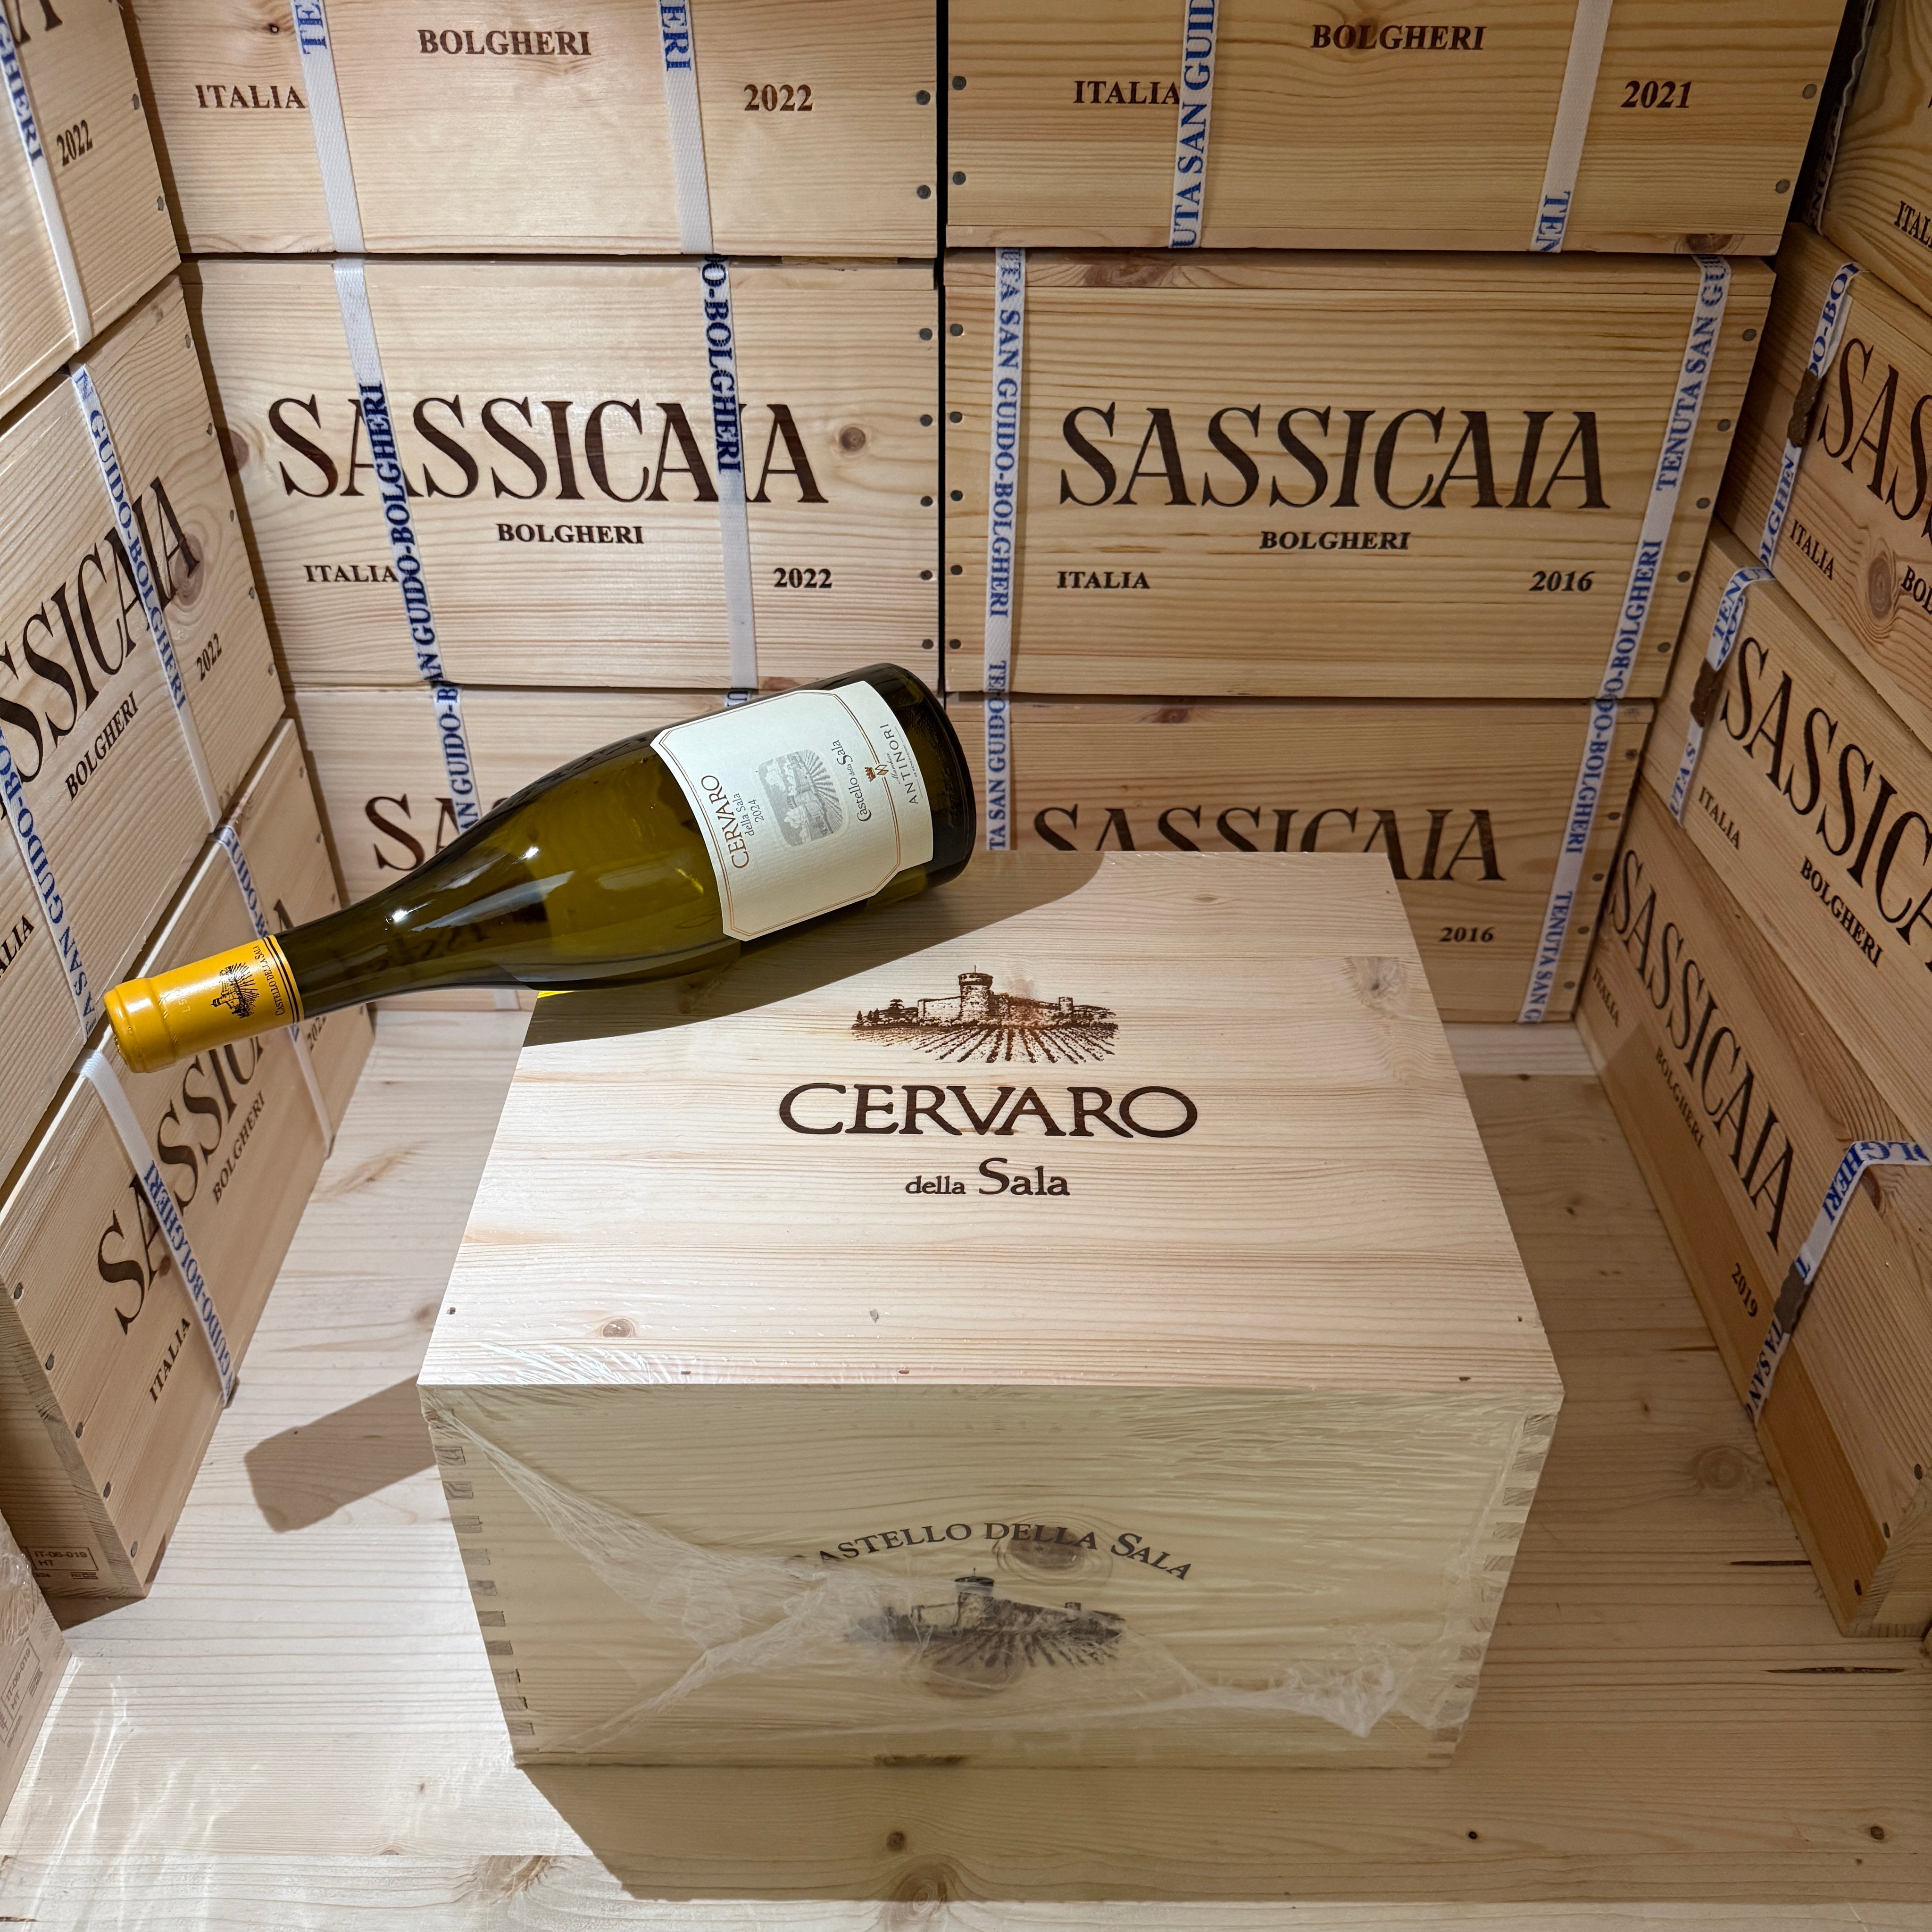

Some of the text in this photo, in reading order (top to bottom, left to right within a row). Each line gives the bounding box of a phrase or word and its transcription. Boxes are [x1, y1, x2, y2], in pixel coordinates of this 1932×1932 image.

[417, 29, 592, 56] BOLGHERI
[1310, 24, 1487, 50] BOLGHERI
[195, 84, 814, 112] ITALIA 2022
[1073, 80, 1692, 108] ITALIA 2021
[57, 119, 93, 167] 2022
[1177, 103, 1207, 175] SAN
[1893, 200, 1932, 249] ITAL
[998, 309, 1021, 369] SAN
[1656, 380, 1702, 491] TENUTA
[1685, 316, 1718, 374] SAN
[268, 394, 829, 503] SASSICAA
[1060, 401, 1611, 510] SASSICAIA
[496, 523, 644, 544] BOLGHERI
[1260, 531, 1411, 550] BOLGHERI
[1790, 519, 1834, 581] ITALIA
[304, 565, 833, 589] ITALIA 2022
[1057, 570, 1596, 592] ITALIA 2016
[196, 633, 223, 682] 2022
[65, 691, 139, 801] BOLGHERI
[832, 740, 854, 766] Sala
[880, 724, 919, 804] ANTINORI
[701, 774, 750, 869] CERVARO
[733, 792, 755, 836] della Sala
[750, 799, 765, 823] 2024
[848, 776, 873, 822] Castello
[988, 779, 1006, 816] SAN
[1698, 786, 1740, 850] ITALIA
[1440, 926, 1496, 943] 2016
[1539, 891, 1573, 966] TENUTA
[1799, 856, 1884, 968] BOLGHERI
[268, 980, 285, 1016] CASTELLO
[1528, 970, 1553, 1005] SAN
[1609, 849, 1794, 1254] SASSICAIA
[779, 1082, 1198, 1138] CERVARO
[1655, 1046, 1705, 1148] BOLGHERI
[213, 1090, 266, 1204] BOLGHERI
[905, 1157, 1071, 1196] della Sala
[1732, 1262, 1758, 1317] 2019
[149, 1317, 191, 1404] ITALIA
[983, 1522, 1099, 1550] DELLA
[1110, 1532, 1192, 1581] SALA
